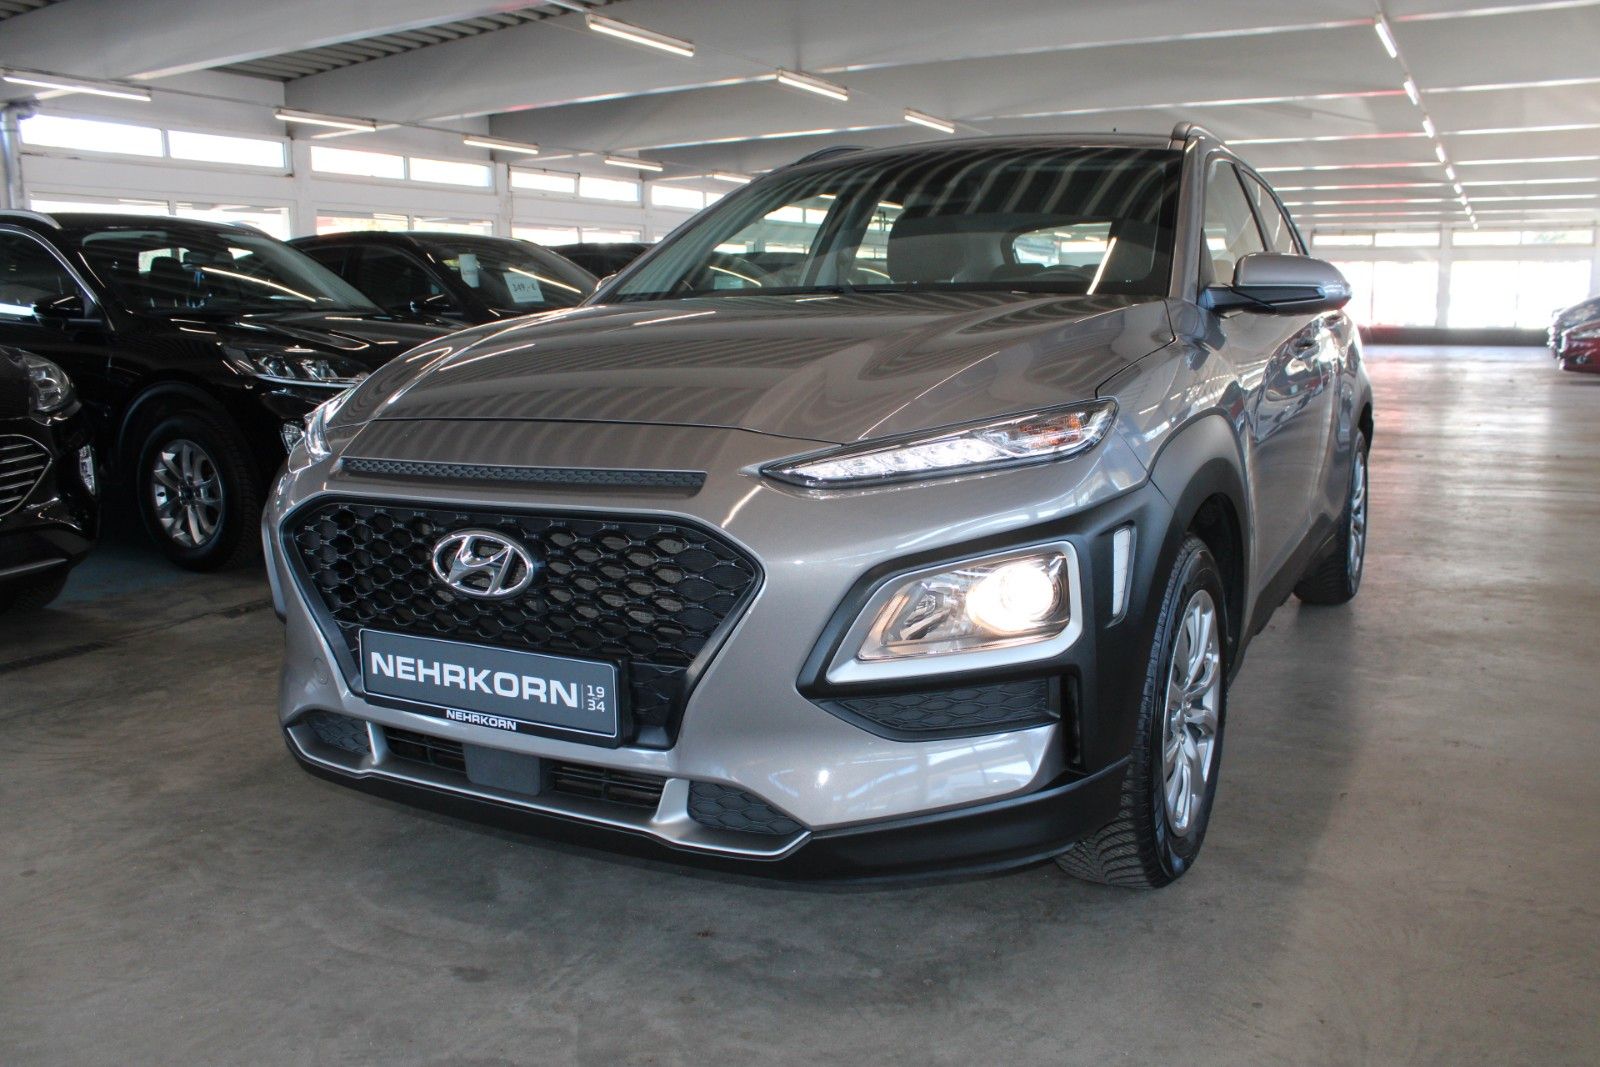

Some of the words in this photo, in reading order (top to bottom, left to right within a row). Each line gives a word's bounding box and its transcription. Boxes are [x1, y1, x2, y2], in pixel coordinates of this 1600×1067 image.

[370, 651, 578, 708] NEHRKORN
[586, 684, 605, 698] 19
[587, 698, 606, 713] 34
[446, 709, 517, 732] NEHRKORN
